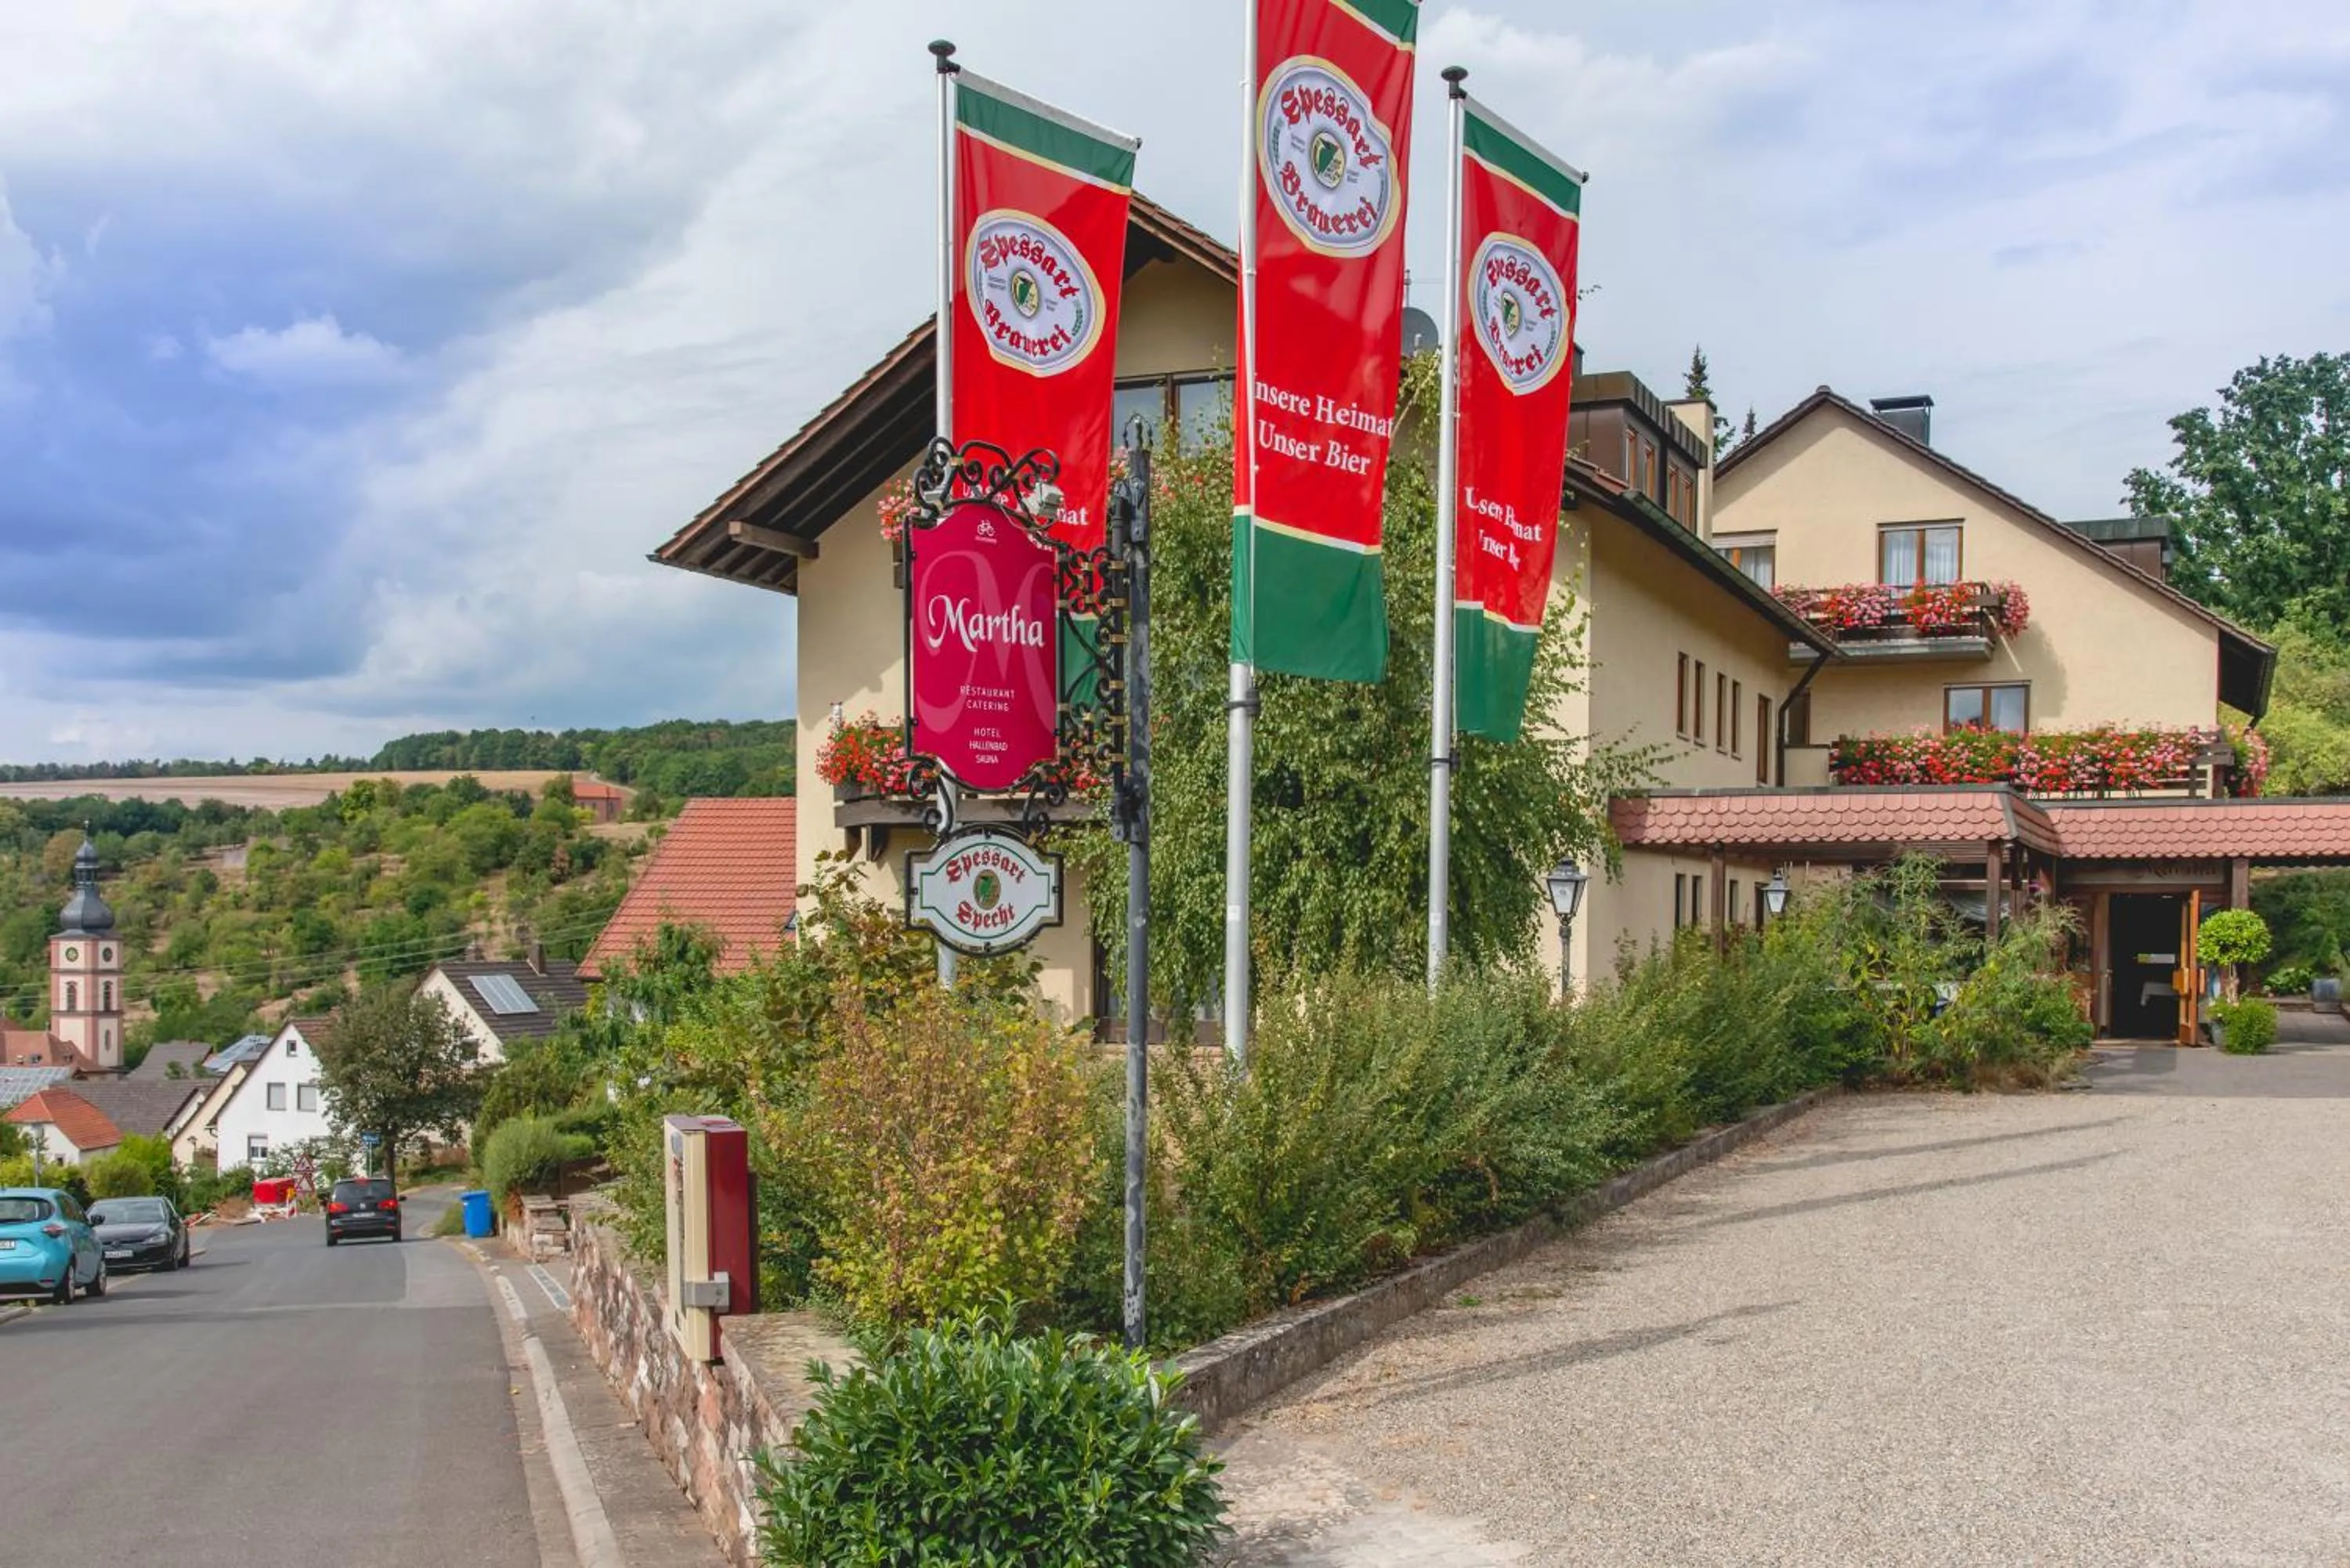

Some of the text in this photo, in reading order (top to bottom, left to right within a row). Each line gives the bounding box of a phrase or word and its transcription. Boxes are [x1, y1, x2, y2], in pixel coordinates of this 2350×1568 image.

[1280, 161, 1378, 235] Brauerei
[1253, 380, 1311, 416] nsere
[1258, 419, 1371, 476] Unser Bier
[927, 594, 1046, 652] Martha
[960, 685, 1015, 699] RESTAURANT
[967, 699, 1010, 712] CATERING
[974, 727, 1001, 738] HOTEL
[945, 846, 1026, 884] Spessart
[956, 901, 1016, 932] Specht
